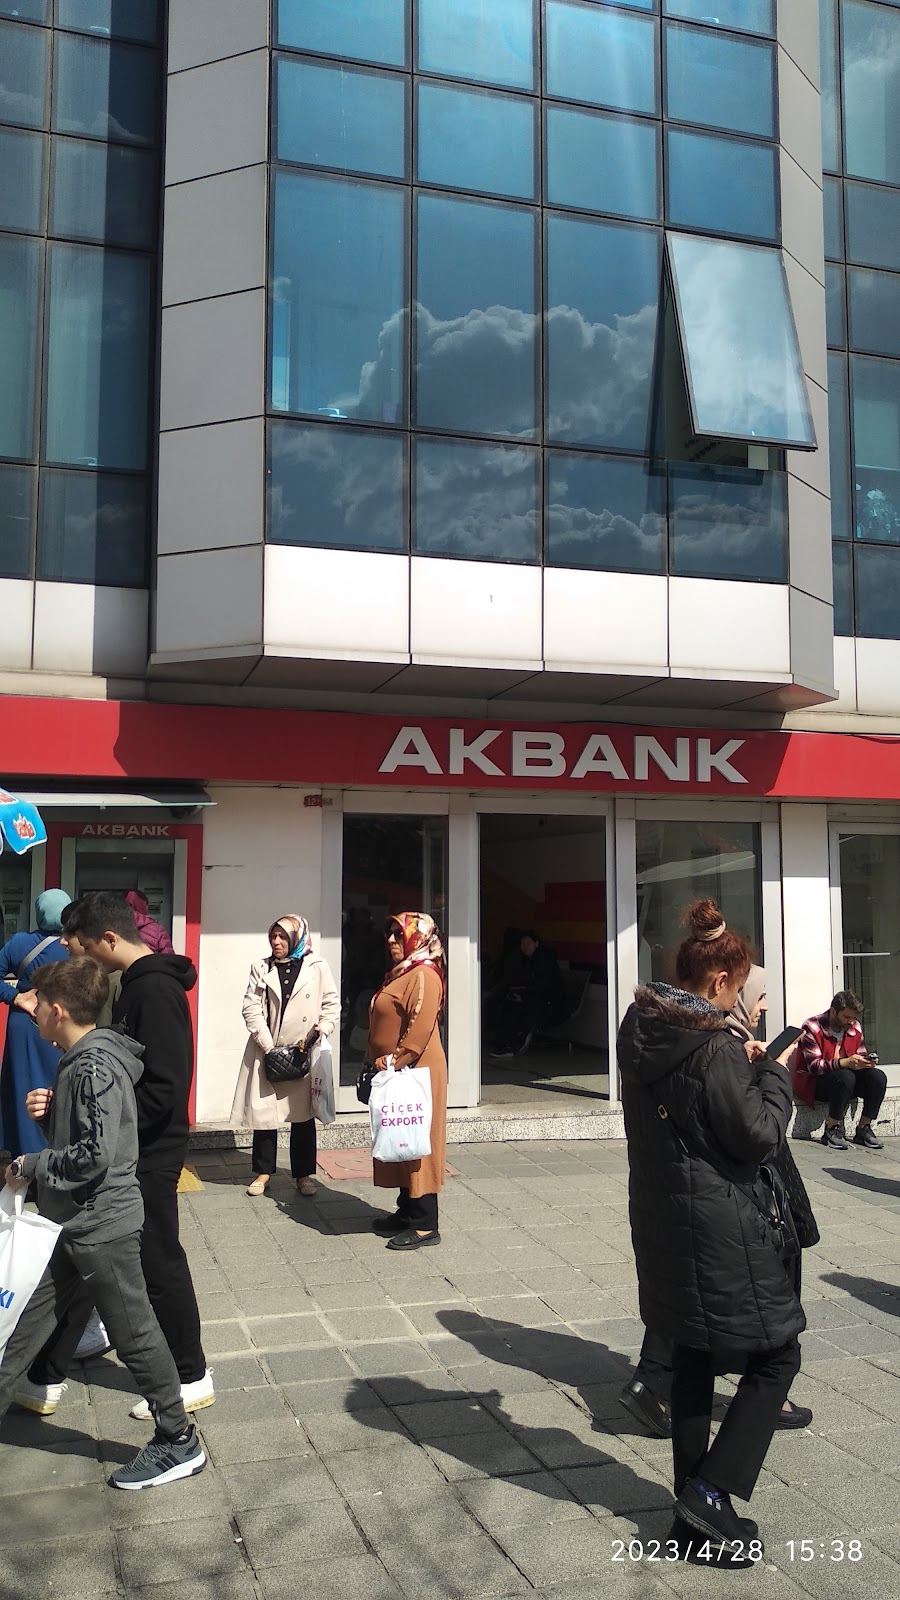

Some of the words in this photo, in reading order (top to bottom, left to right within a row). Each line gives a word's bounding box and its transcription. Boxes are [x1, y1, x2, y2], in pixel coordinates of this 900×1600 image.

[378, 726, 749, 783] AKBANK
[82, 824, 170, 836] AKBANK
[381, 1102, 423, 1115] ÇİÇEK
[381, 1116, 424, 1127] EXPORT
